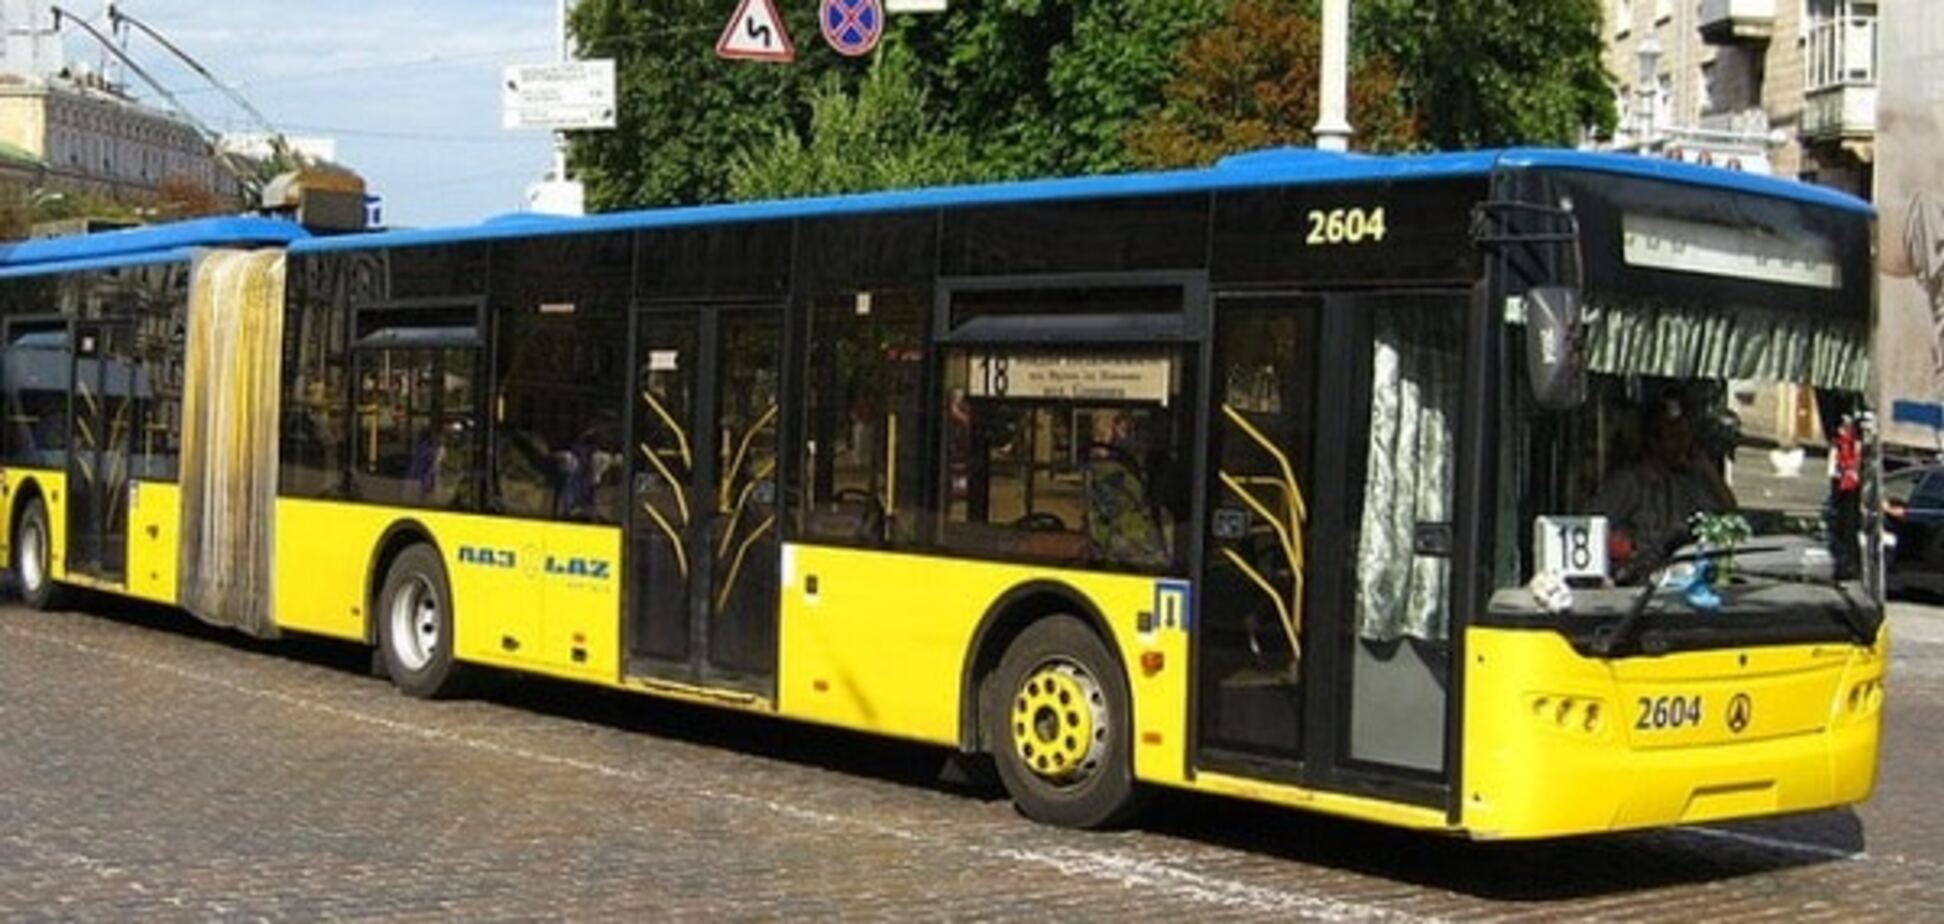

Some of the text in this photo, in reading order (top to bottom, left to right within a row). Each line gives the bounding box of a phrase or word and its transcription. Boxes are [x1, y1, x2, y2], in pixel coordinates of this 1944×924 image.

[1306, 207, 1386, 244] 2604
[979, 355, 1008, 396] 18
[1558, 525, 1590, 570] 18
[544, 556, 610, 580] LAZ
[1634, 695, 1703, 730] 2604
